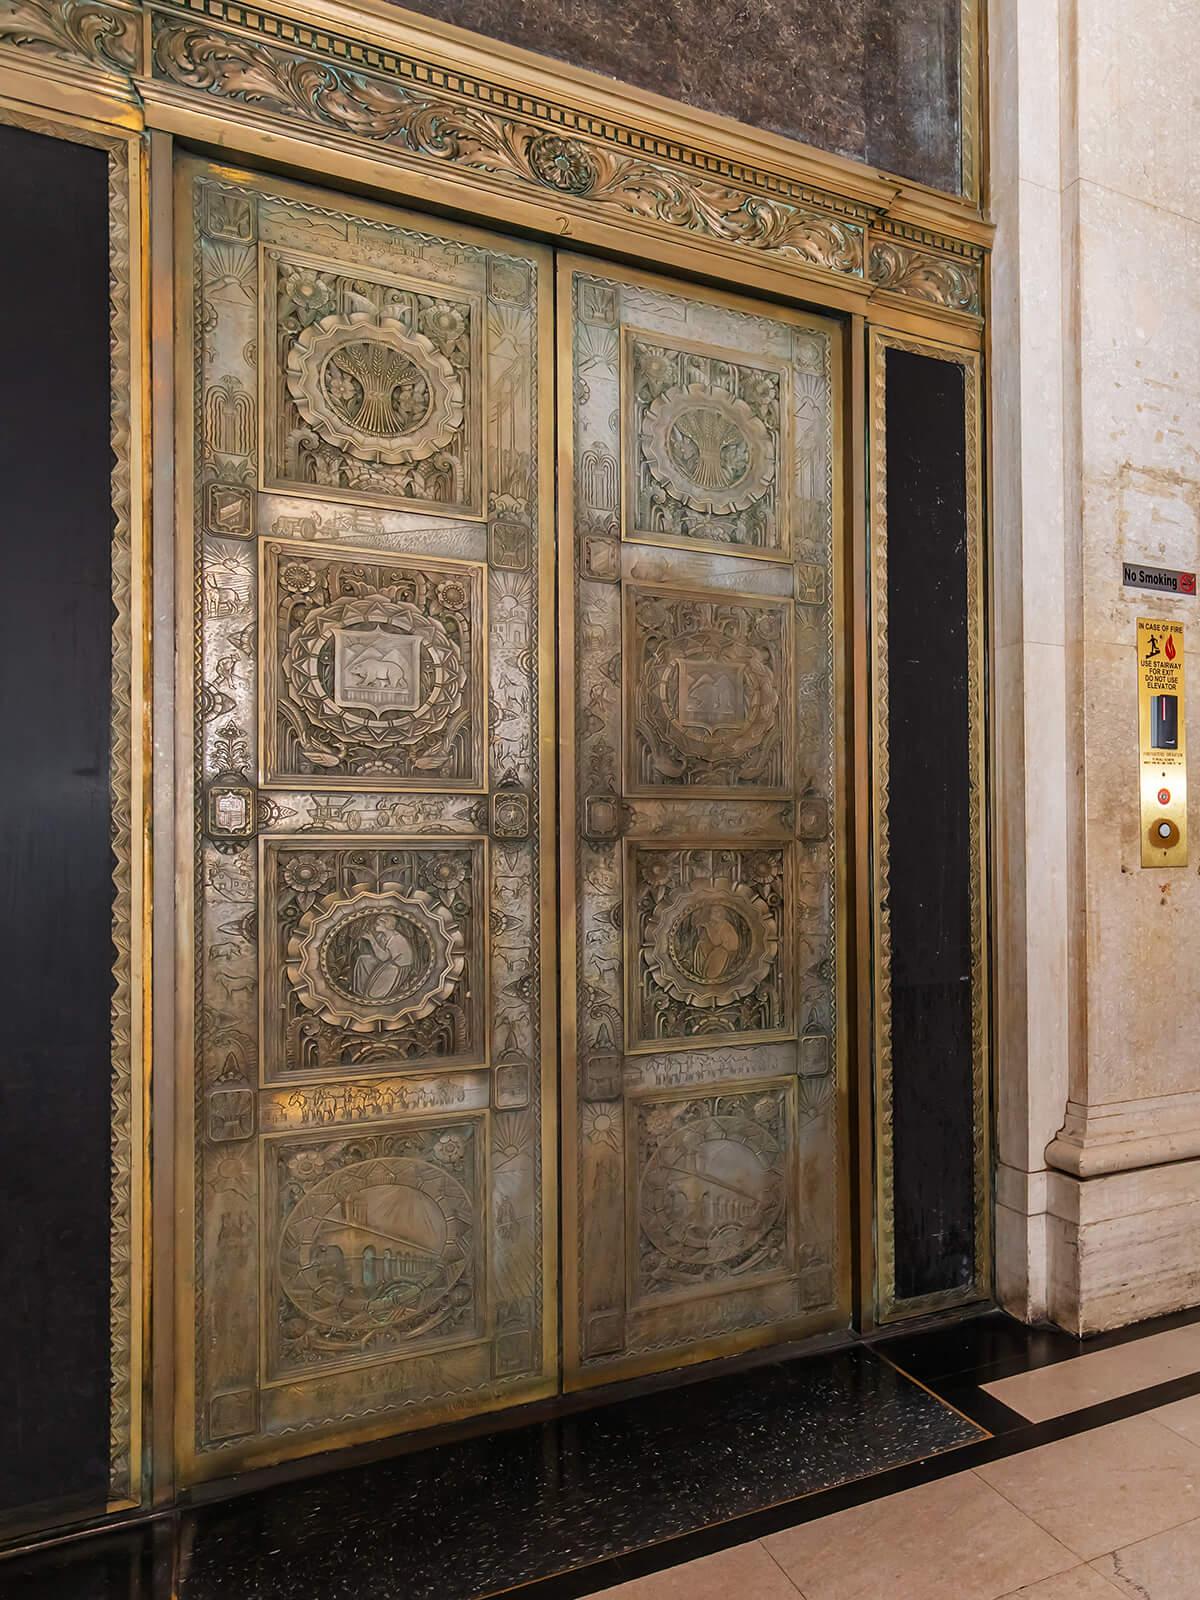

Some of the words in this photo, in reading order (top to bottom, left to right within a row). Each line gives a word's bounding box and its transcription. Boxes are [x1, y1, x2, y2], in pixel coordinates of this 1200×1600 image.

[555, 216, 573, 236] 2
[1124, 567, 1137, 582] No
[1138, 570, 1178, 590] Smoking
[1138, 622, 1145, 630] IN
[1145, 623, 1161, 631] CASE
[1161, 624, 1169, 632] OF
[1170, 625, 1183, 634] FIRE
[1141, 659, 1152, 667] USE
[1153, 660, 1182, 670] STAIRWAY
[1149, 667, 1161, 675] FOR
[1161, 668, 1175, 676] EXIT
[1144, 674, 1154, 682] DO
[1154, 675, 1166, 683] NOT
[1167, 676, 1179, 684] USE
[1147, 681, 1177, 691] ELEVATOR
